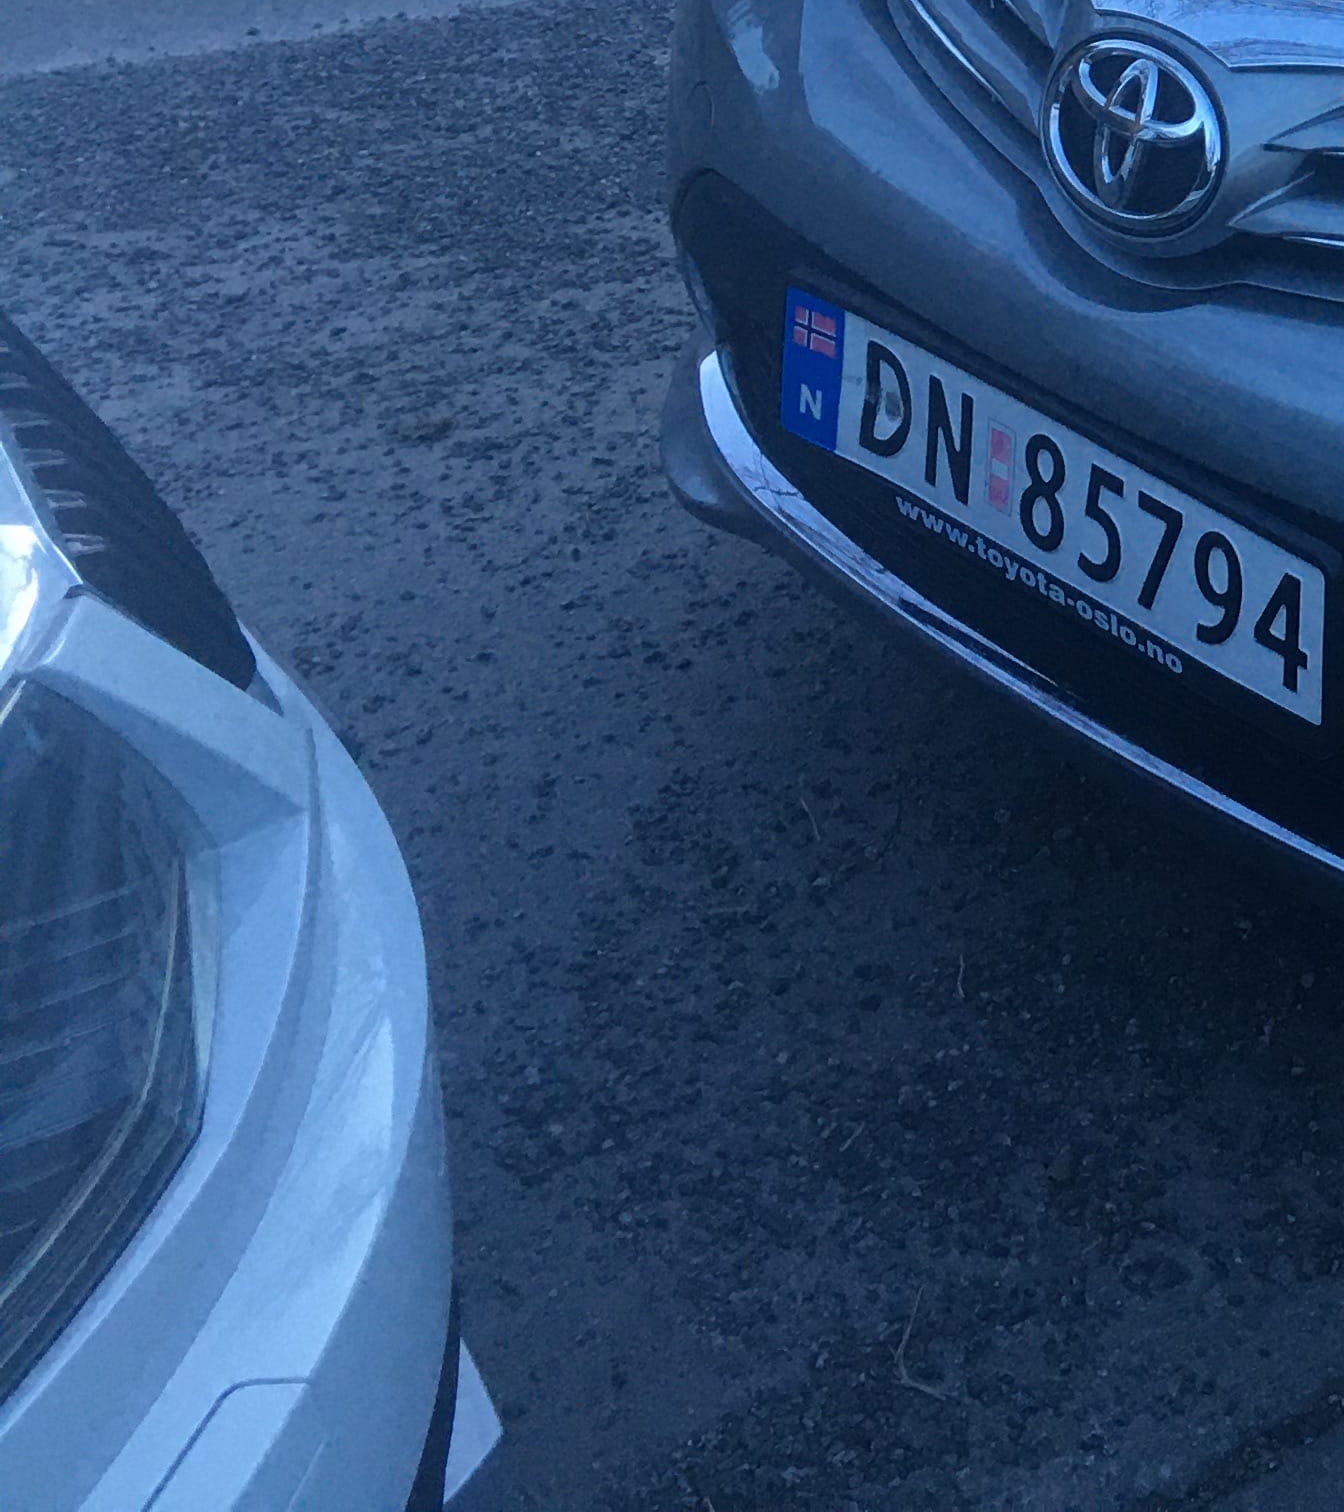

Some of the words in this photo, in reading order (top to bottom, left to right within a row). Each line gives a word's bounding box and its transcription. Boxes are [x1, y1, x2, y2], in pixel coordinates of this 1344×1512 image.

[799, 384, 822, 421] N
[859, 340, 975, 506] DN
[1018, 433, 1308, 693] 85794
[895, 494, 1184, 675] www.toyota-oslo.no
